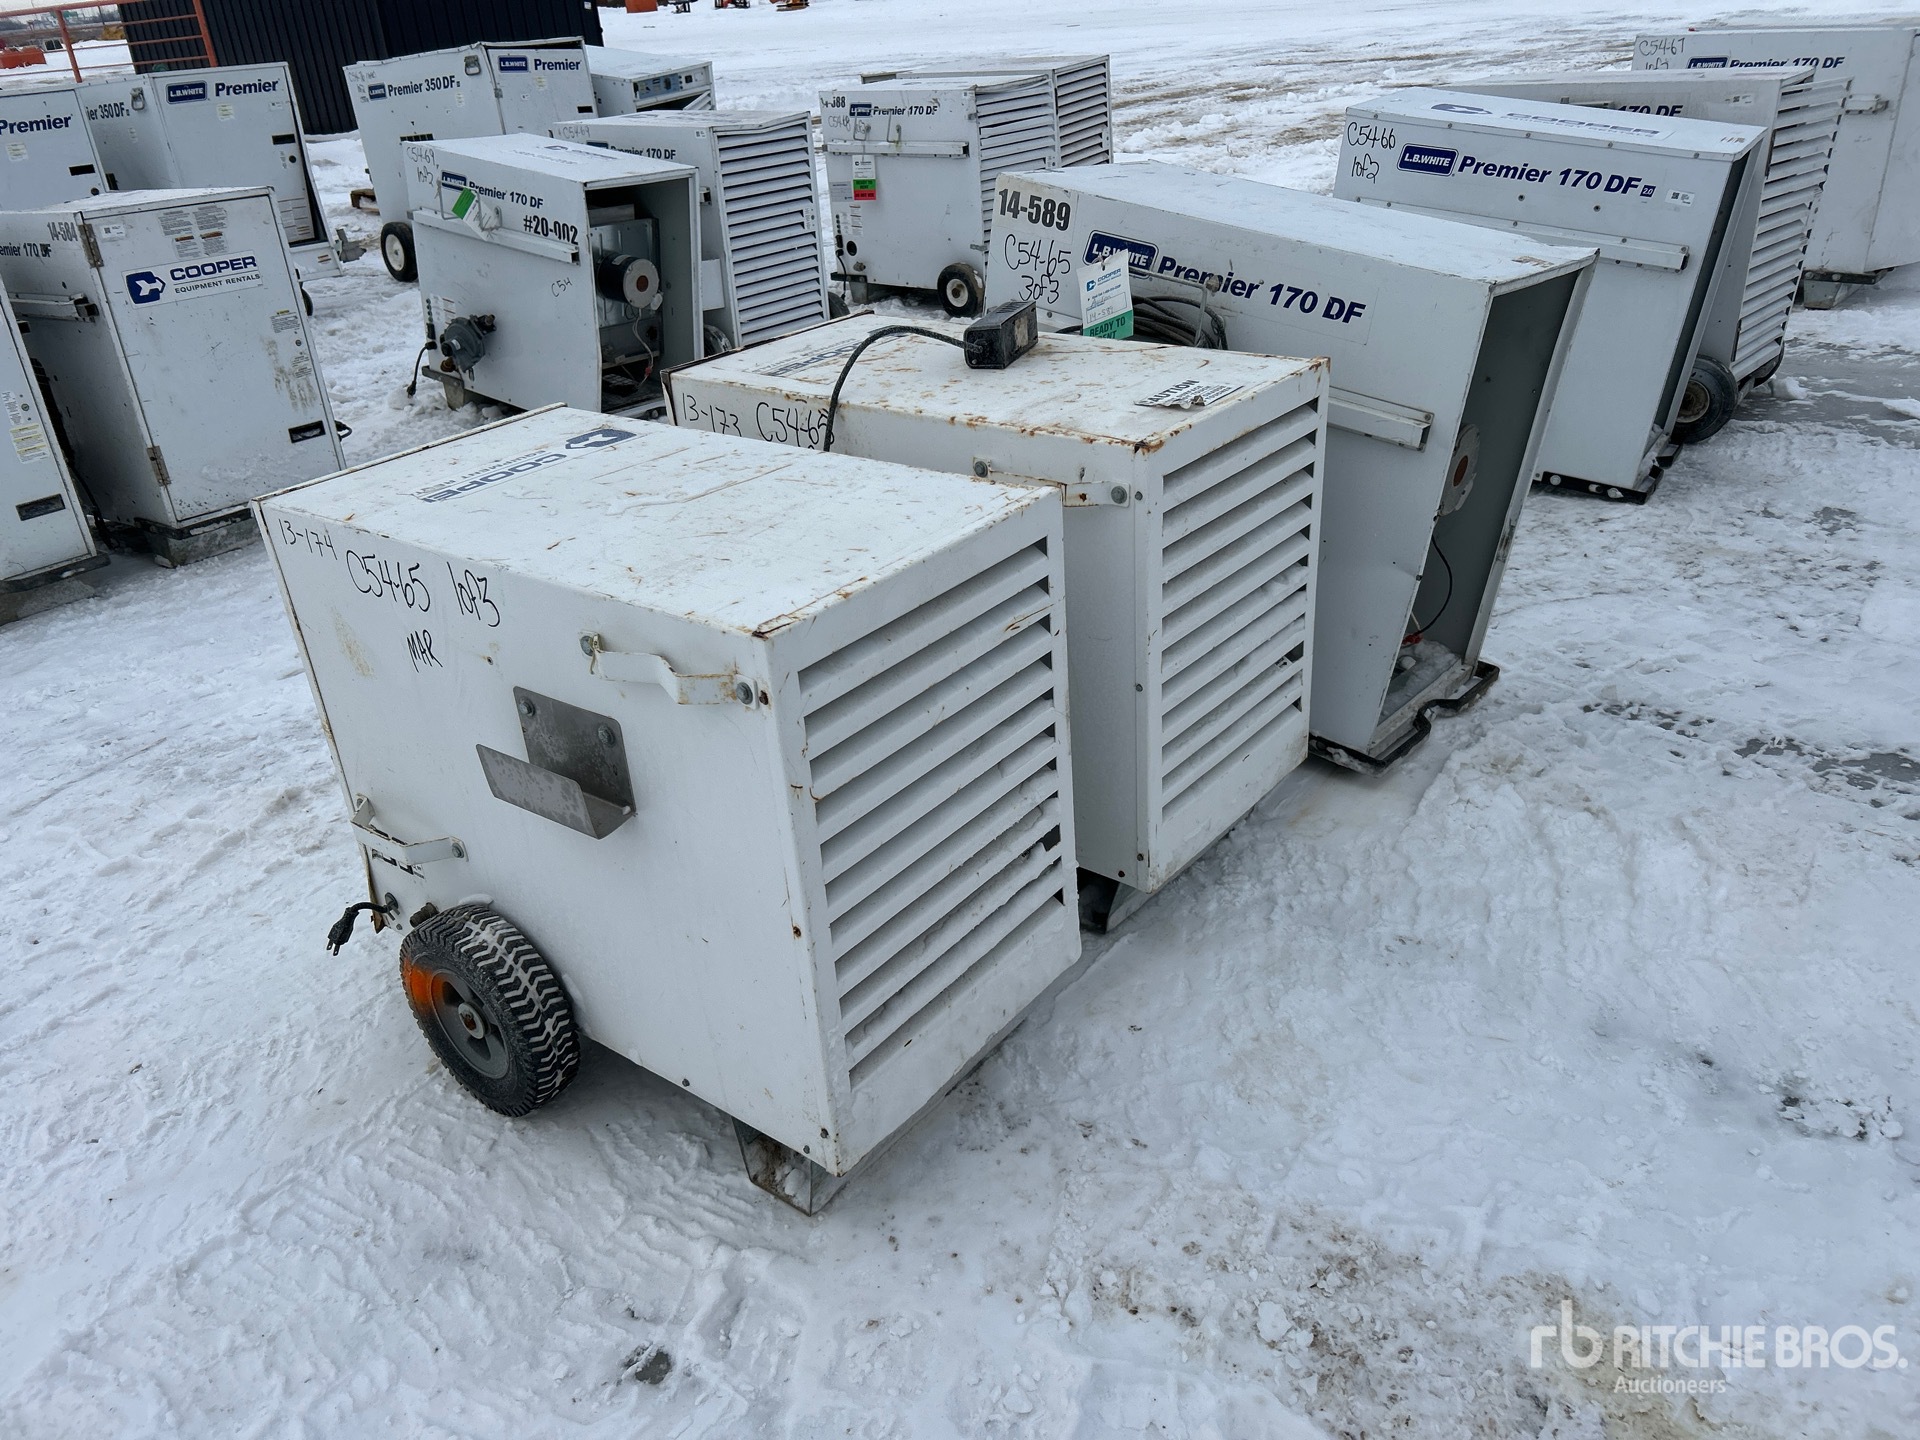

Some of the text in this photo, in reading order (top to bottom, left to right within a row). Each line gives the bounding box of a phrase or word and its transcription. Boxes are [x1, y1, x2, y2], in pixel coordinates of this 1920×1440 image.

[534, 58, 580, 71] Premier
[1822, 57, 1845, 69] DF
[215, 79, 278, 97] Premier
[388, 75, 456, 97] Premier 350 DF
[98, 103, 114, 119] 350
[114, 102, 126, 117] DF
[908, 105, 925, 116] 170
[0, 115, 71, 135] Premier
[646, 148, 662, 158] 170
[664, 149, 676, 159] DF
[1404, 152, 1451, 167] L.B.WHITE
[1458, 156, 1551, 183] Premier
[1559, 168, 1602, 190] 170
[1604, 174, 1642, 194] DF
[509, 191, 528, 206] 170
[529, 196, 543, 209] DF
[998, 188, 1071, 232] 14-589
[47, 221, 79, 242] 14-584
[523, 214, 579, 246] #20-002
[23, 242, 40, 258] 170
[1004, 233, 1071, 277] C54-65
[169, 255, 257, 281] COOPER
[174, 273, 261, 294] EQUIPMENT RENTALS
[551, 277, 573, 298] C54
[1018, 273, 1060, 305] 3of3
[1158, 255, 1259, 300] Premier
[1269, 283, 1318, 314] 170
[1322, 296, 1366, 325] DF
[1089, 315, 1126, 337] READY TO
[278, 518, 338, 560] 13-174
[346, 550, 431, 612] C54-65
[406, 629, 443, 673] MAR
